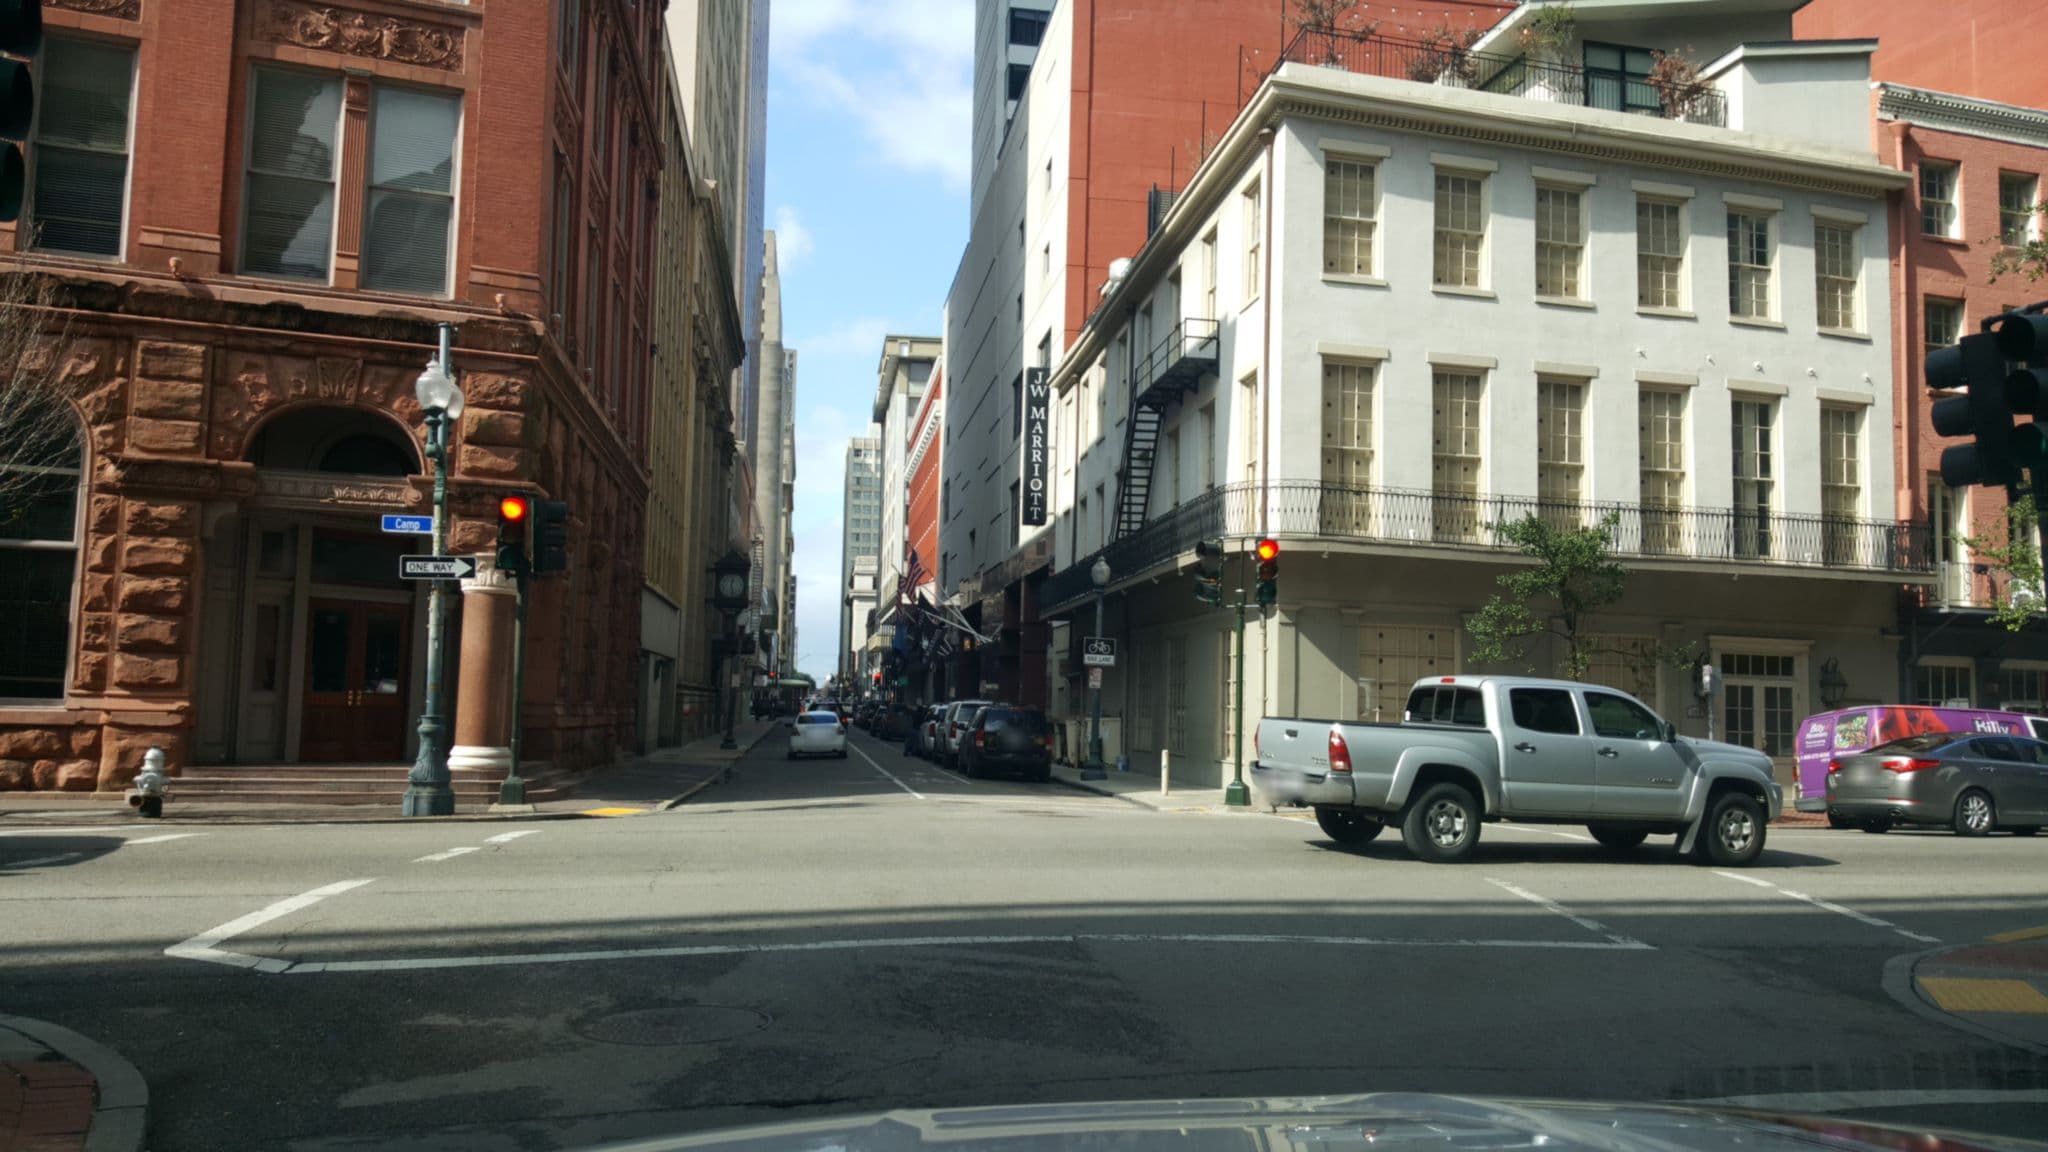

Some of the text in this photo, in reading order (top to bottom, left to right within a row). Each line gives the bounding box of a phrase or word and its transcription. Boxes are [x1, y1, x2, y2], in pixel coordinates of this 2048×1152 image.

[1029, 371, 1047, 520] JW MARRIOTT
[395, 519, 420, 530] Camp
[408, 563, 454, 572] ONE WAY
